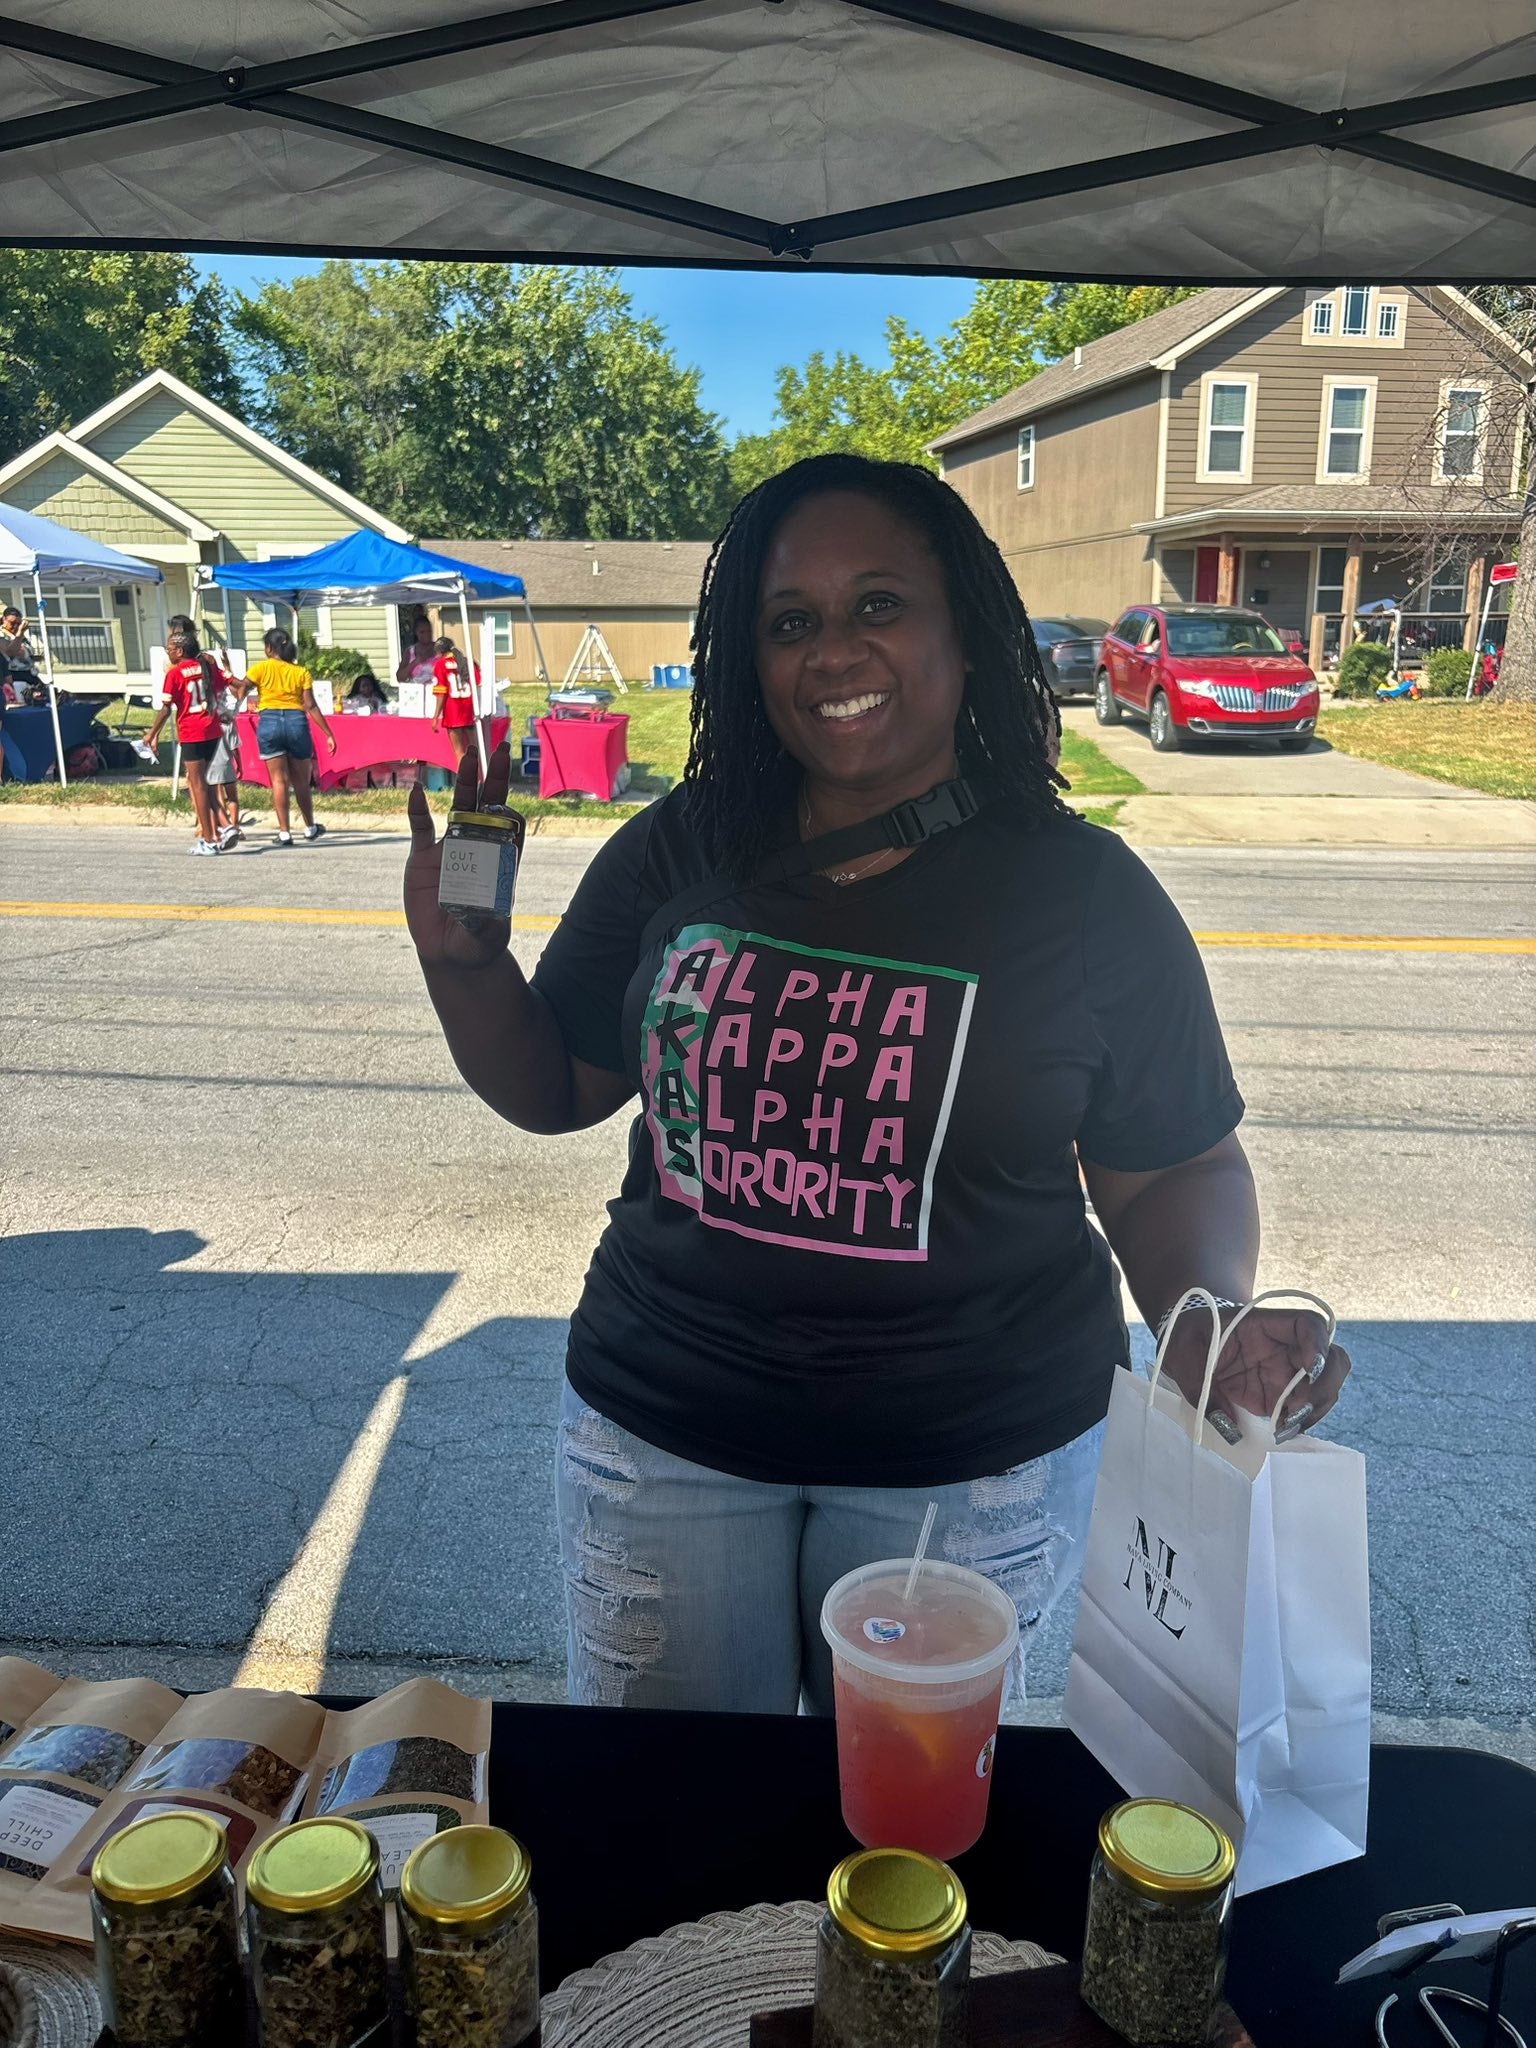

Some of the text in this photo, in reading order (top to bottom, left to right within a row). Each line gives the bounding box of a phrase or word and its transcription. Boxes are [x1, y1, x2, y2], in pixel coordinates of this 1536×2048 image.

[445, 862, 478, 874] LOVE
[449, 850, 475, 861] GUT
[668, 947, 928, 1037] ALPHA
[655, 1001, 914, 1102] KAPPA
[656, 1068, 905, 1166] ALPHA
[665, 1128, 917, 1236] SORORITY
[1126, 1543, 1193, 1611] NAVA LIVING COMPANY
[0, 1831, 43, 1851] DEEP
[8, 1817, 54, 1840] CHILL
